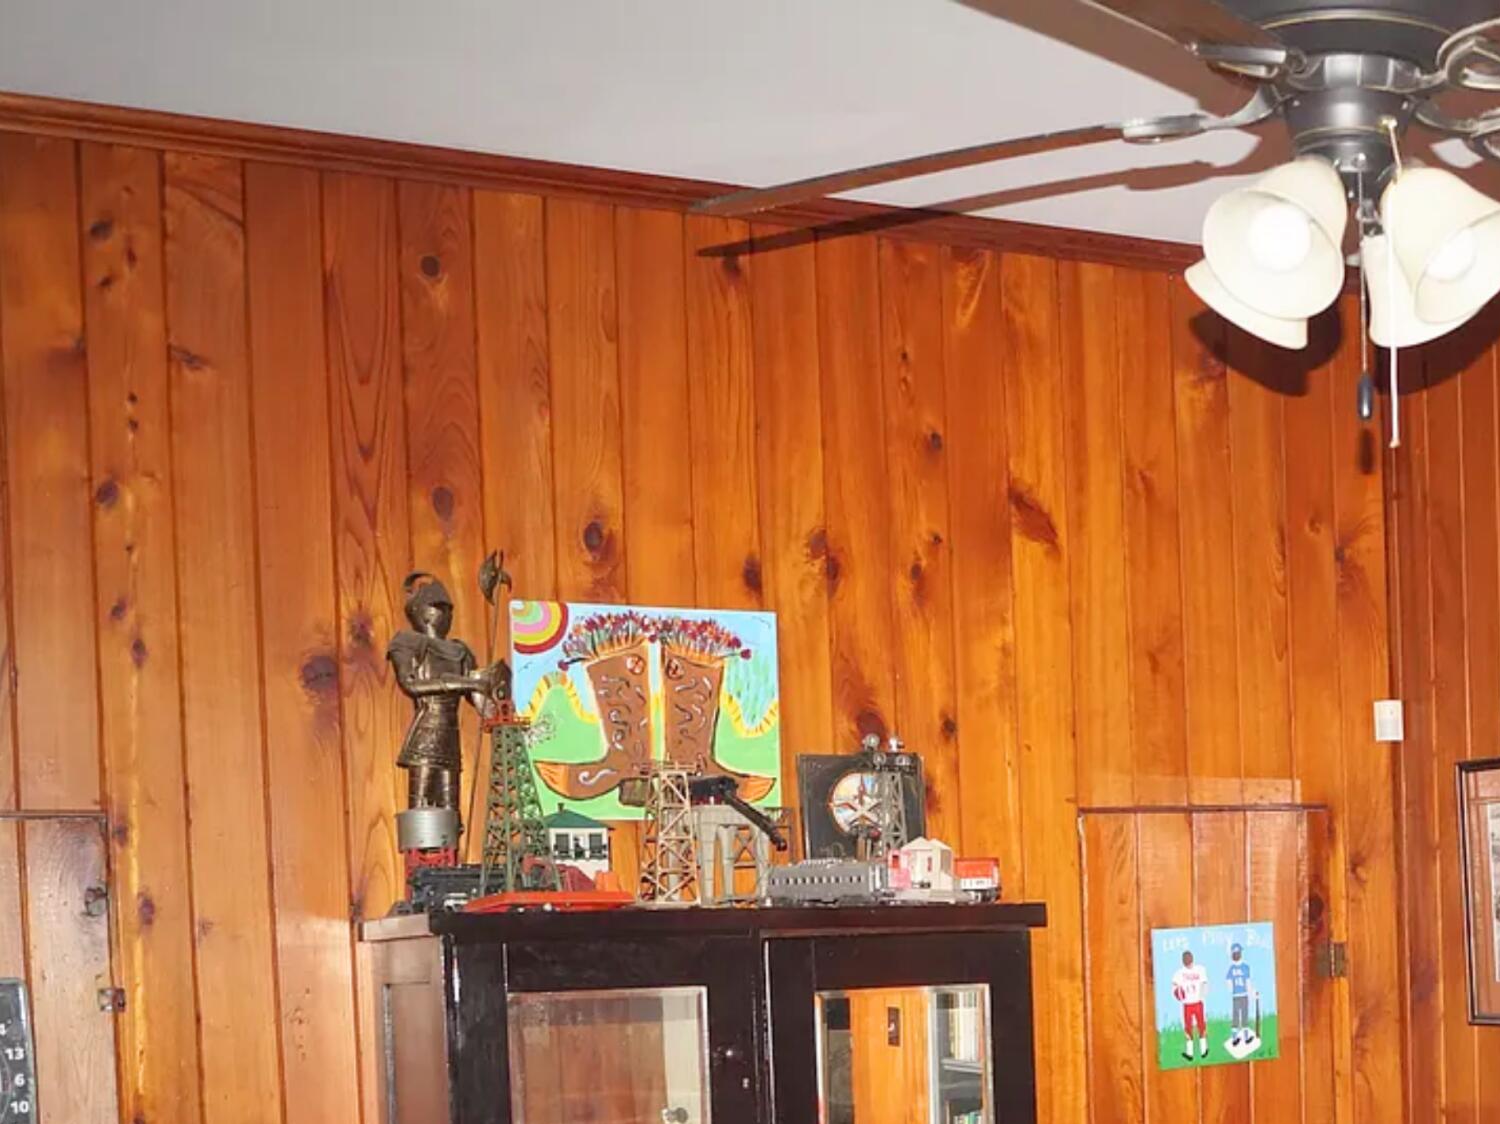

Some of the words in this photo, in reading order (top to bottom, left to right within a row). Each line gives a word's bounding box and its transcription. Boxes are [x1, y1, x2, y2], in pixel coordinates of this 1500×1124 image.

[4, 1048, 25, 1060] 13
[14, 1075, 25, 1087] 6
[10, 1101, 29, 1114] 10
